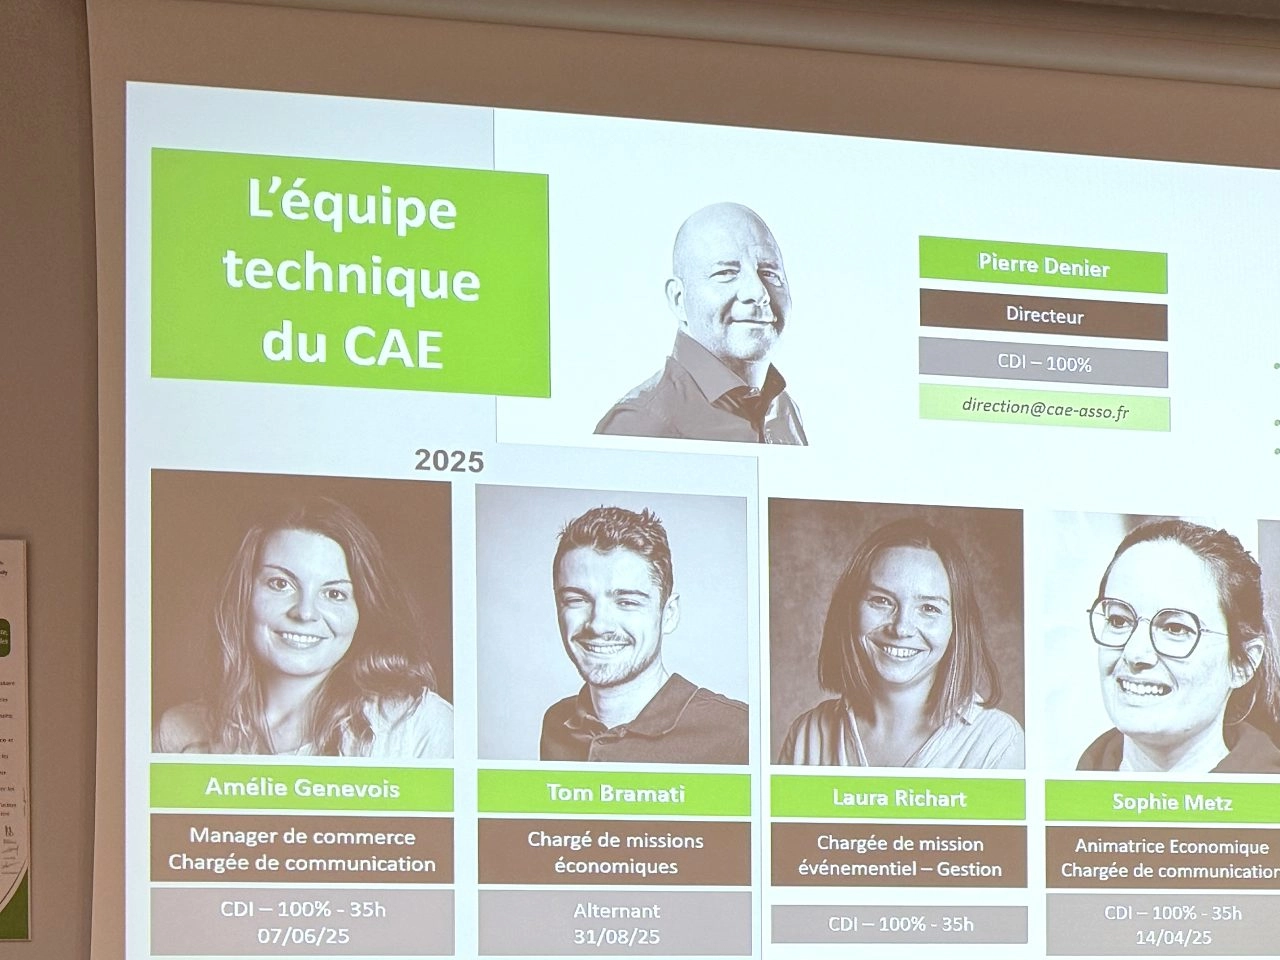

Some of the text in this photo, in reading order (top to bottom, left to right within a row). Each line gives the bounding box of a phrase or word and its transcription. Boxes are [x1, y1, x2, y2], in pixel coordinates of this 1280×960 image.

[248, 176, 458, 238] L’équipe
[978, 252, 1110, 278] Pierre Denier
[223, 248, 482, 307] technique
[1007, 305, 1085, 325] Directeur
[263, 319, 444, 370] du CAE
[998, 353, 1027, 369] CDI
[1047, 356, 1093, 373] 100%
[962, 397, 1129, 422] direction@cae-asso.fr
[414, 448, 485, 475] 2025
[205, 776, 401, 801] Amélie Genevois
[546, 783, 686, 804] Tom Bramati
[833, 789, 967, 809] Laura Richart
[1112, 794, 1233, 814] Sophie Metz
[189, 827, 416, 850] Manager de commerce
[527, 830, 705, 853] Chargé de missions
[817, 834, 985, 856] Chargée de mission
[1075, 838, 1270, 860] Animatrice Economique
[168, 853, 437, 876] Chargée de communication
[554, 857, 679, 880] économiques
[799, 860, 917, 879] événementiel
[936, 861, 1002, 878] Gestion
[1061, 861, 1134, 882] Chargée
[1135, 862, 1157, 879] de
[219, 901, 256, 918] CDI
[276, 900, 332, 918] 100%
[349, 900, 387, 918] 35h
[573, 902, 661, 920] Alternant
[1104, 905, 1133, 921] CDI
[1152, 905, 1197, 921] 100%
[1211, 905, 1242, 922] 35h
[828, 916, 858, 933] CDI
[878, 916, 926, 933] 100%
[942, 915, 974, 933] 35h
[257, 926, 350, 947] 07/06/25
[573, 927, 661, 948] 31/08/25
[1136, 929, 1213, 949] 14/04/25
